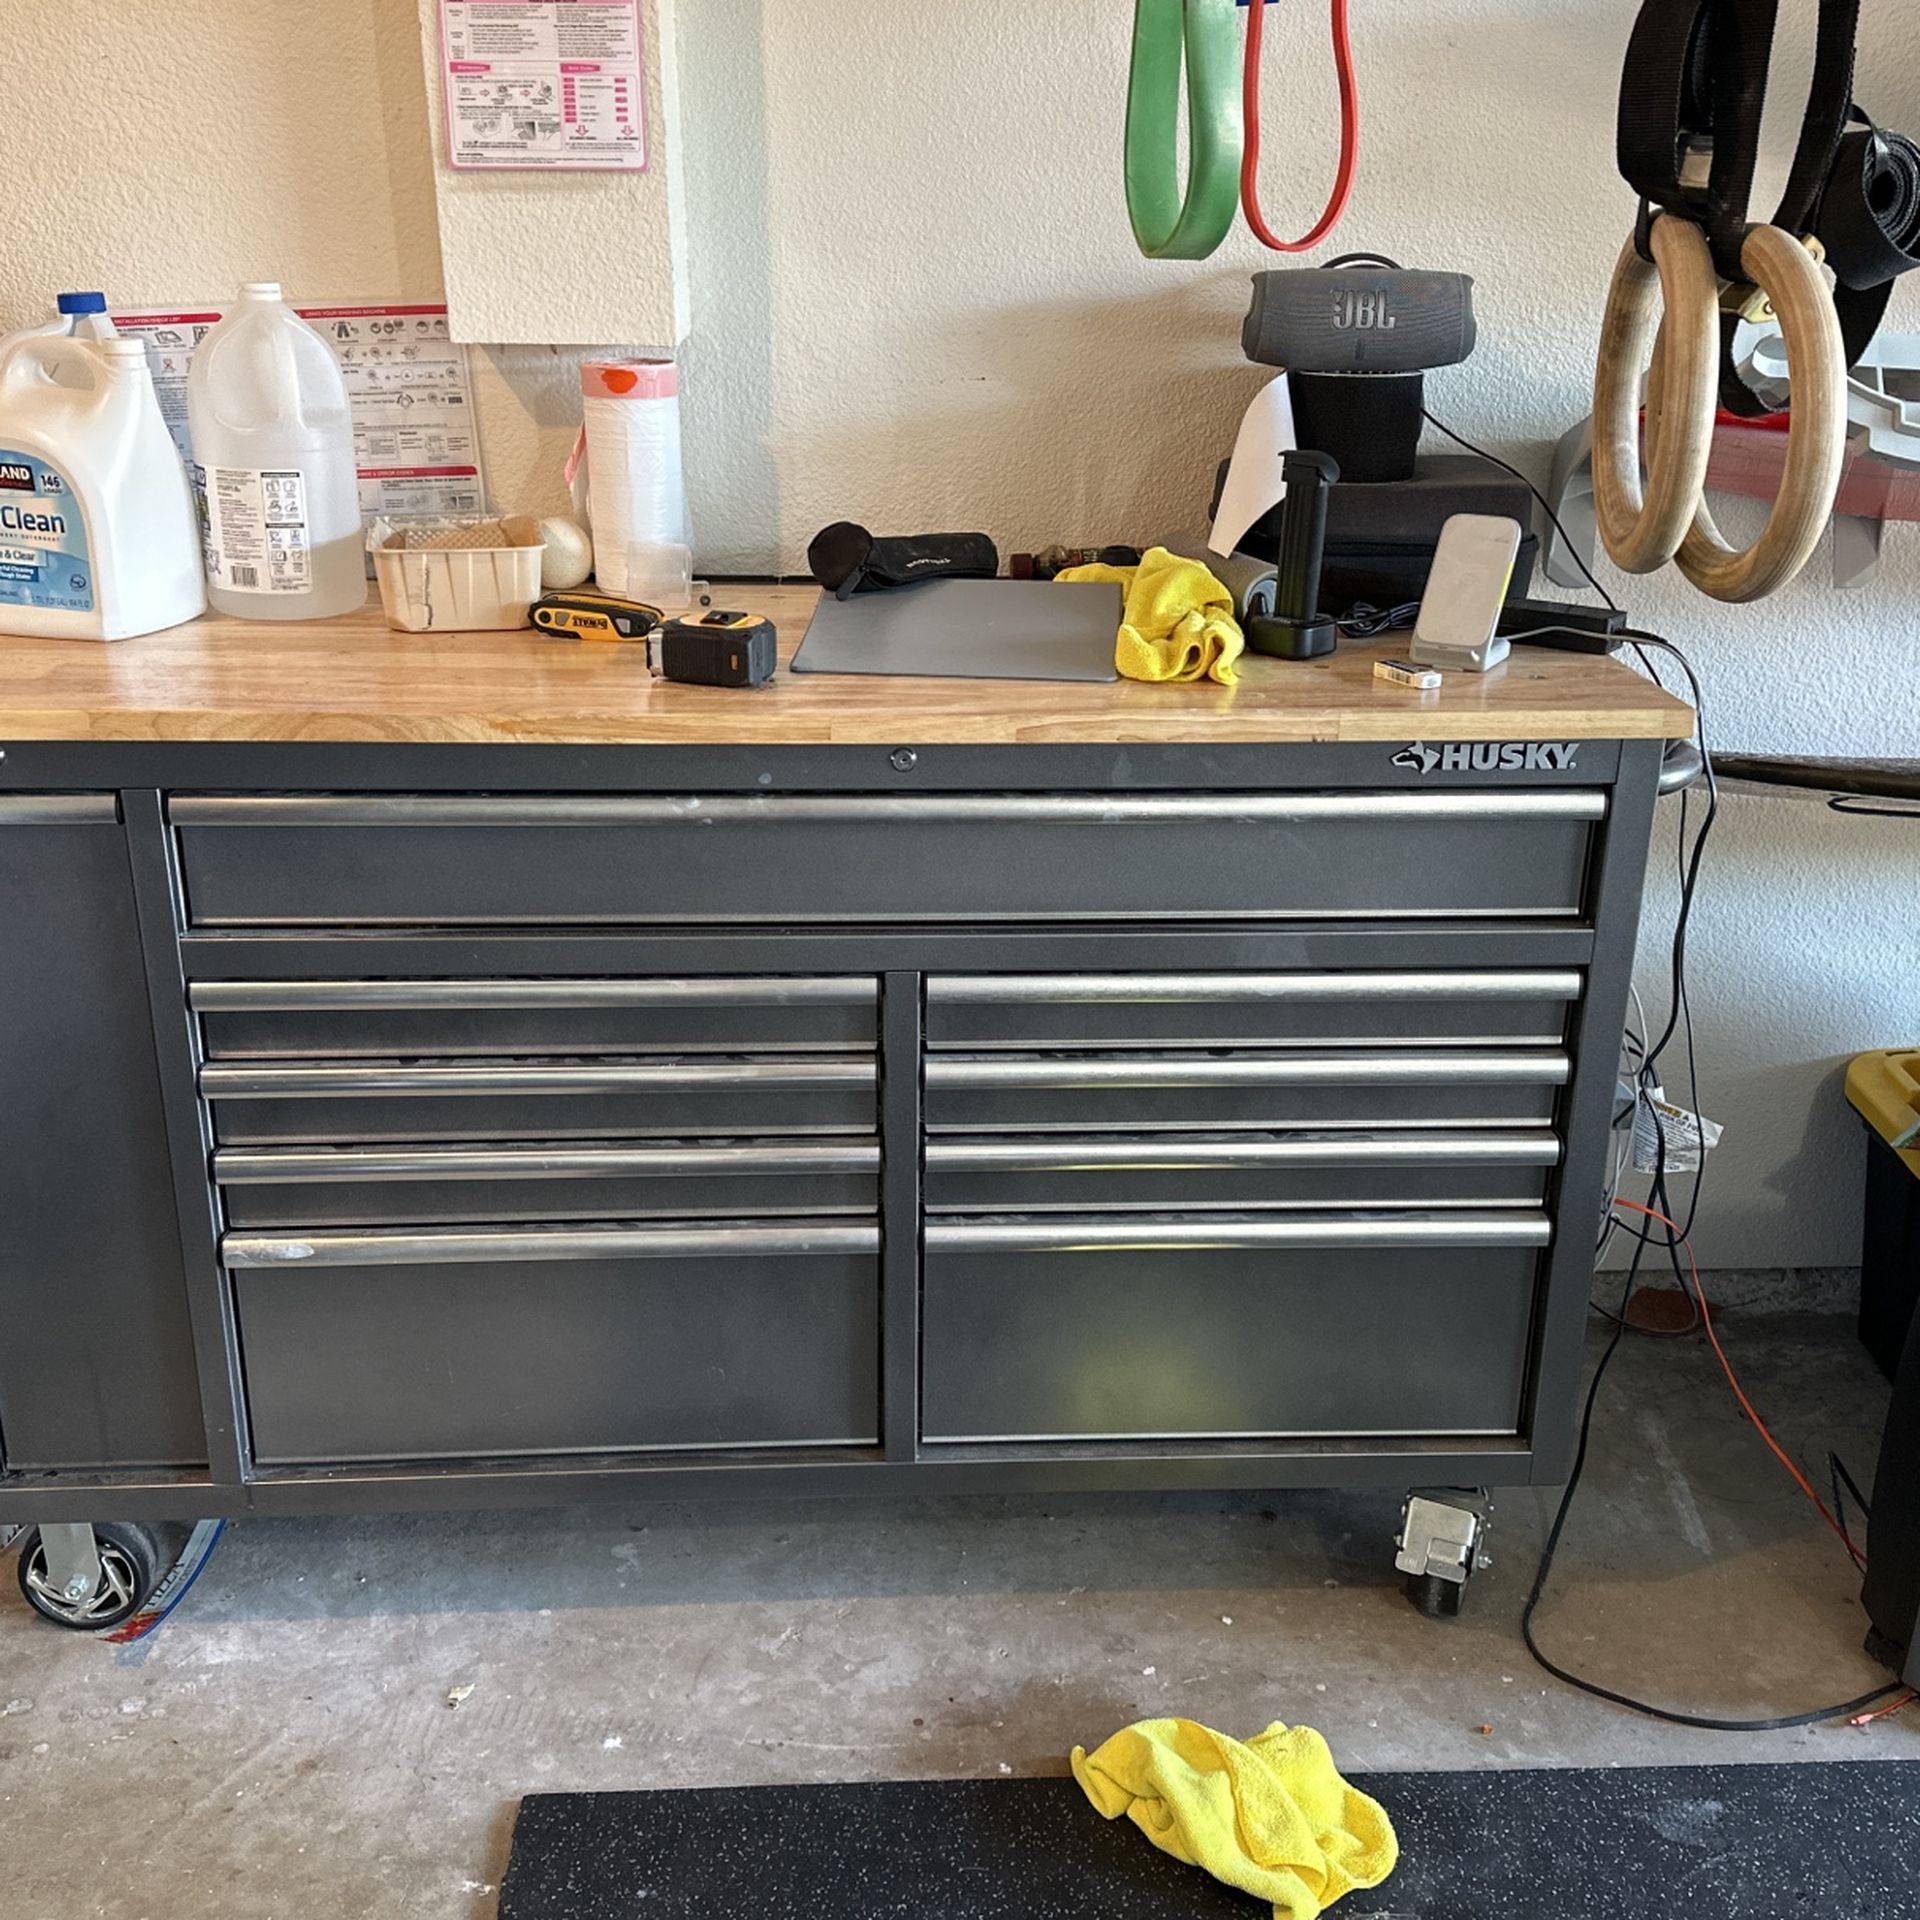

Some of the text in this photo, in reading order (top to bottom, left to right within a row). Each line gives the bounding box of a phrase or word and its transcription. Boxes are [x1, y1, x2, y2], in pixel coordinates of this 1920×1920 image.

[1330, 288, 1396, 329] JBL
[1, 505, 65, 534] Clean
[12, 550, 35, 561] Clear
[1442, 742, 1579, 771] HUSKY
